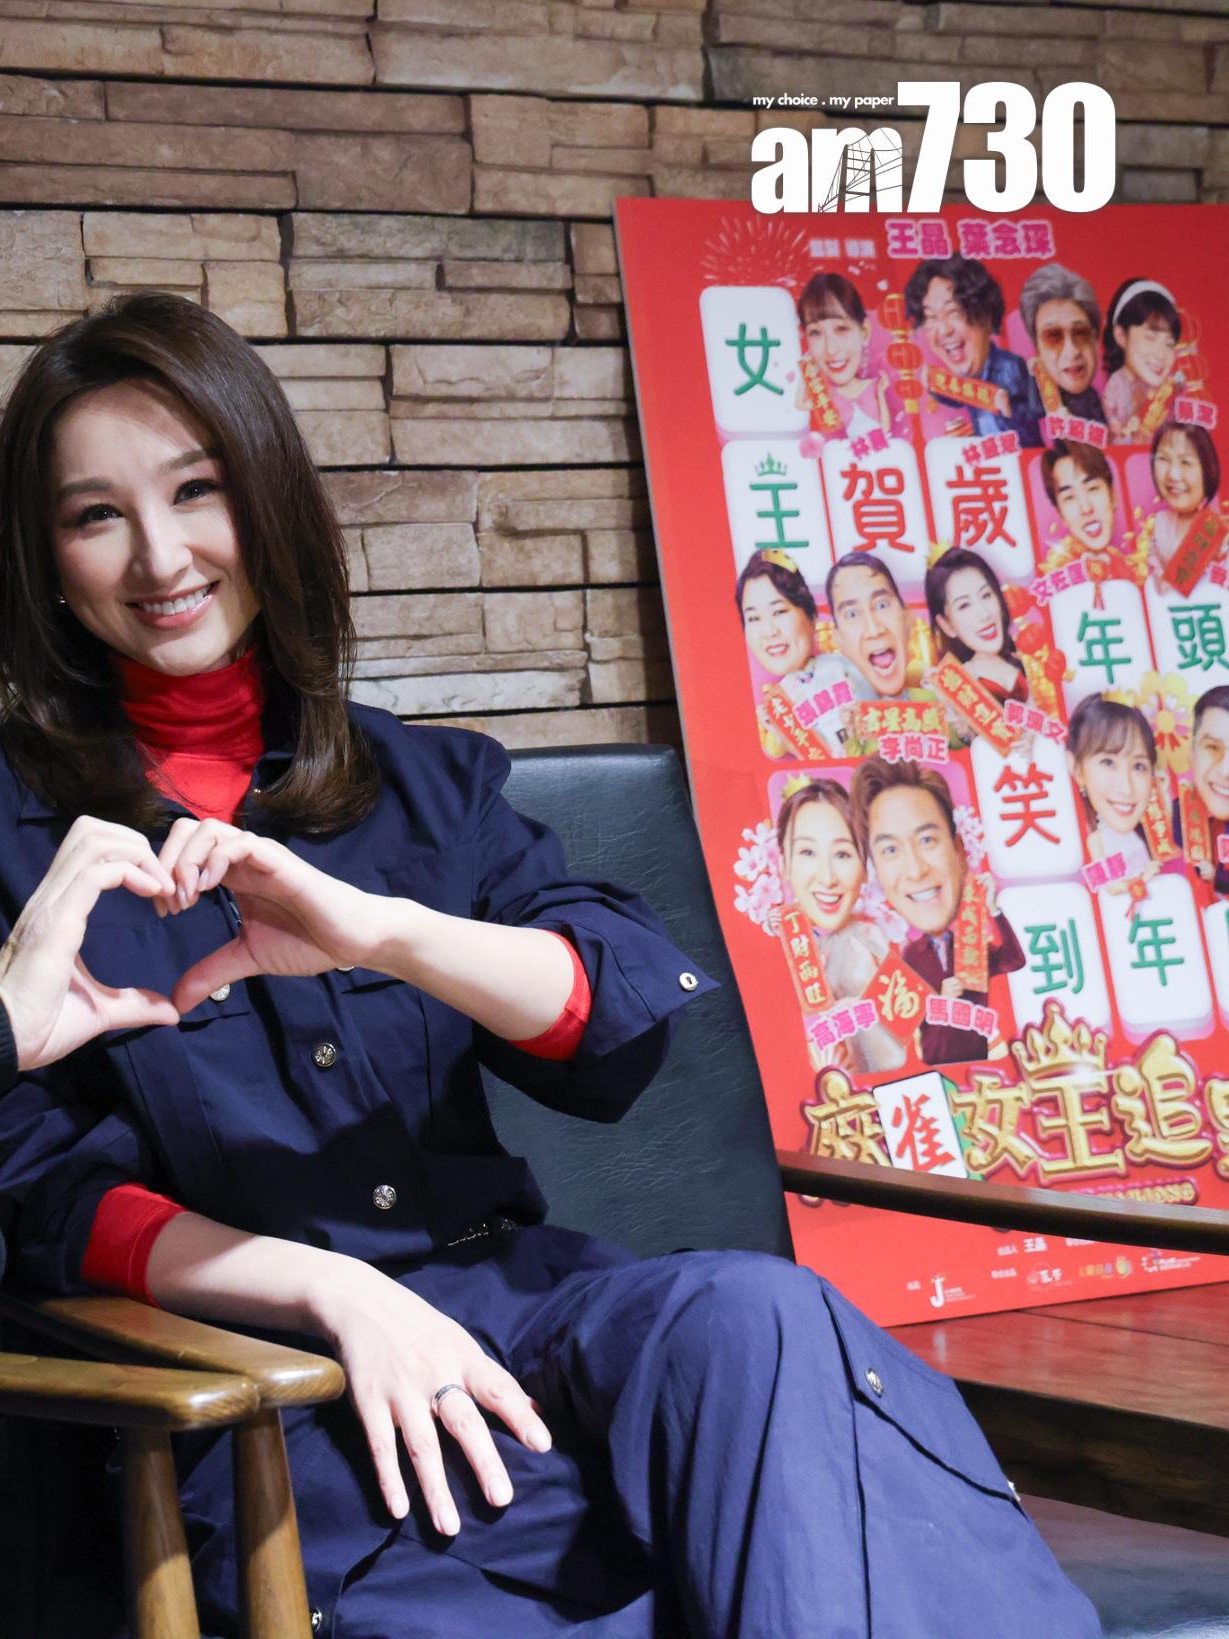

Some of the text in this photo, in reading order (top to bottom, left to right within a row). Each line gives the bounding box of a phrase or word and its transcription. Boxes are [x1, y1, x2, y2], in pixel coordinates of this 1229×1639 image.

[886, 220, 952, 258] 王晶
[725, 323, 785, 396] 女
[879, 734, 947, 764] 李尚正
[994, 762, 1061, 848] 笑
[877, 969, 923, 1022] 福
[928, 996, 996, 1038] 馬國明
